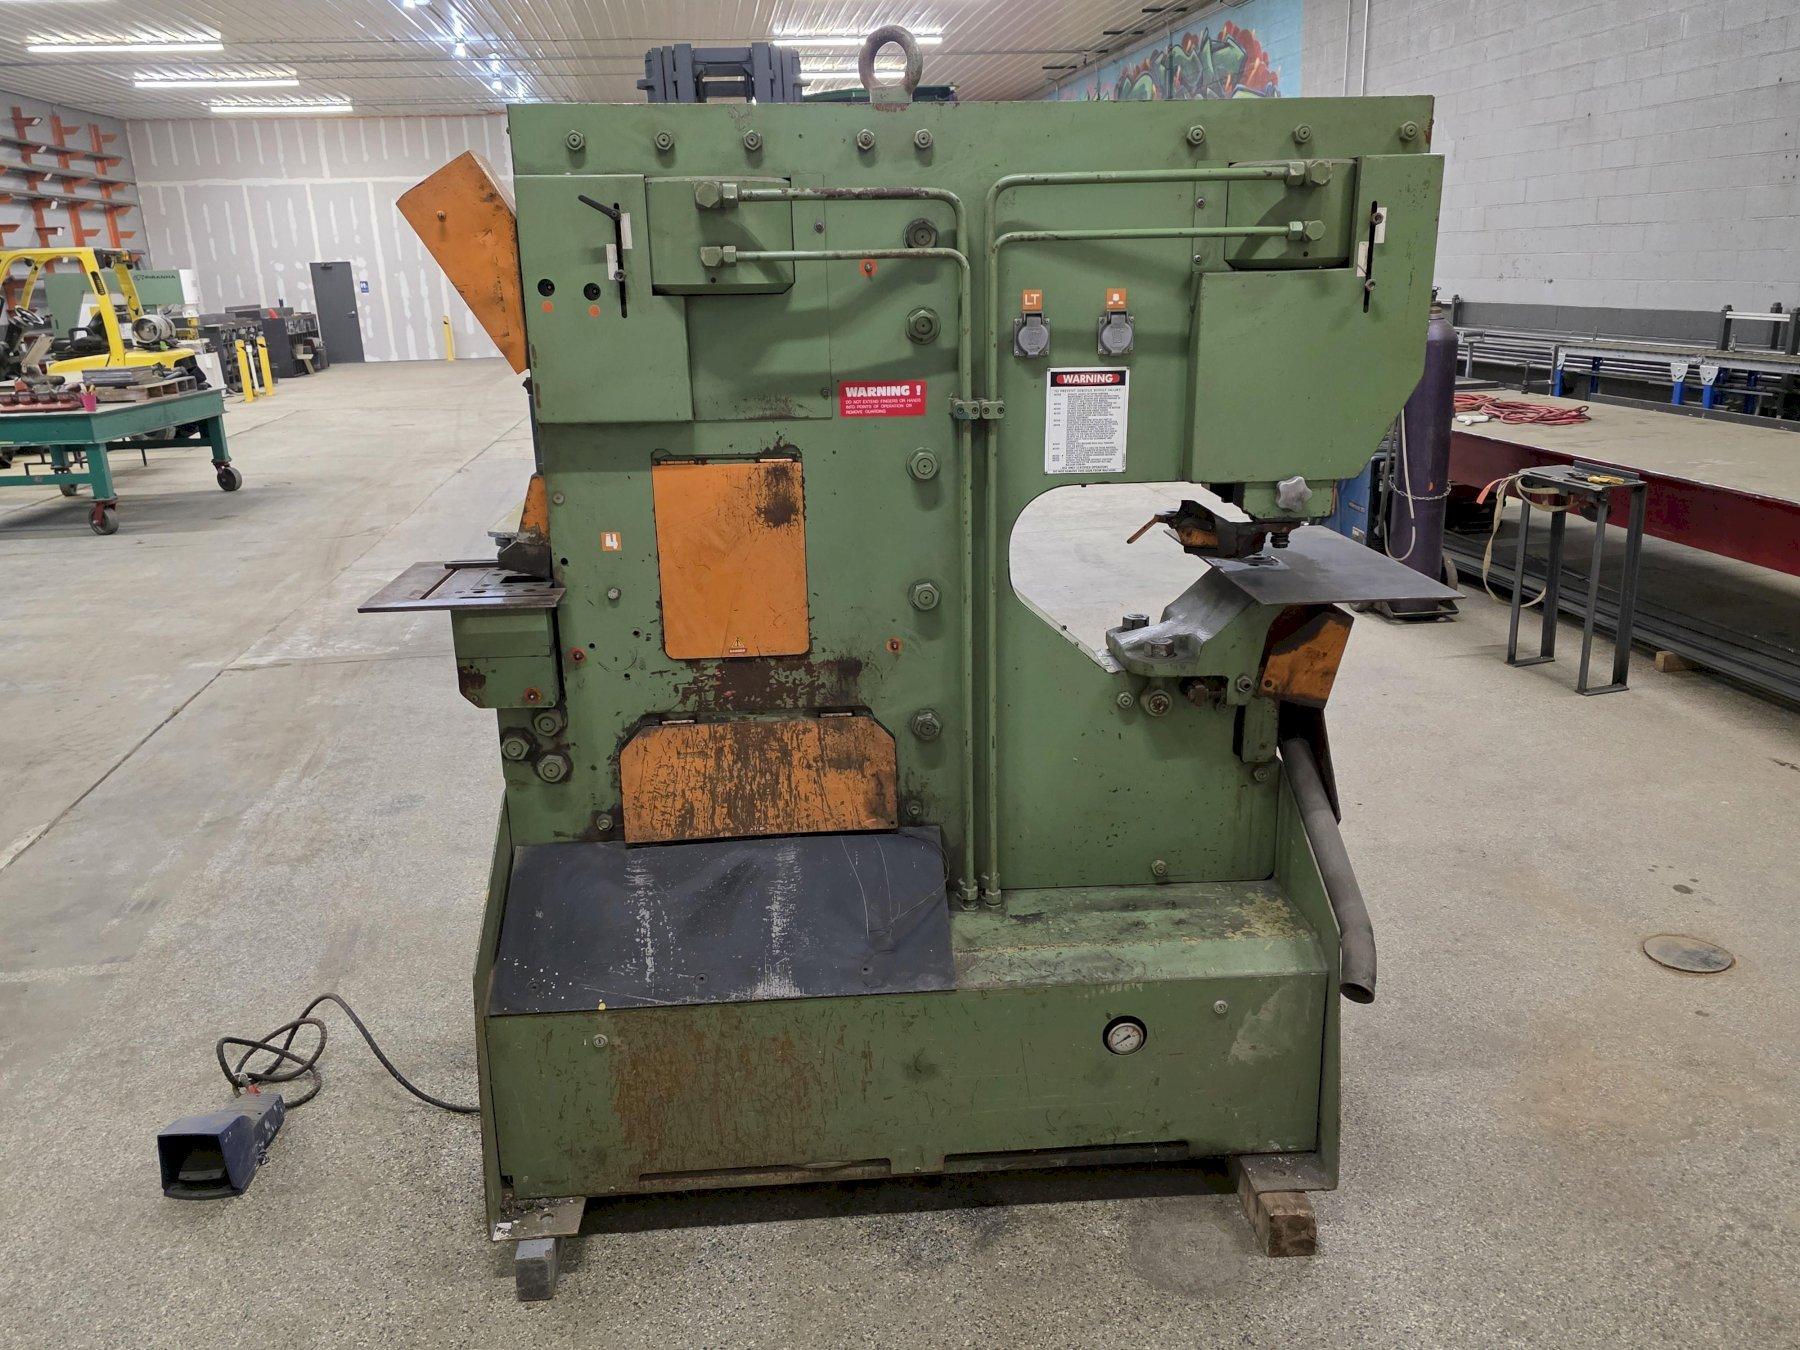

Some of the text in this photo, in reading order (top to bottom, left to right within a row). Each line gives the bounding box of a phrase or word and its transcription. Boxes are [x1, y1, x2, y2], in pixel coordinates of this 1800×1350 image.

[1025, 294, 1040, 305] LT
[1062, 374, 1114, 384] WARNING
[845, 385, 922, 397] WARNING !
